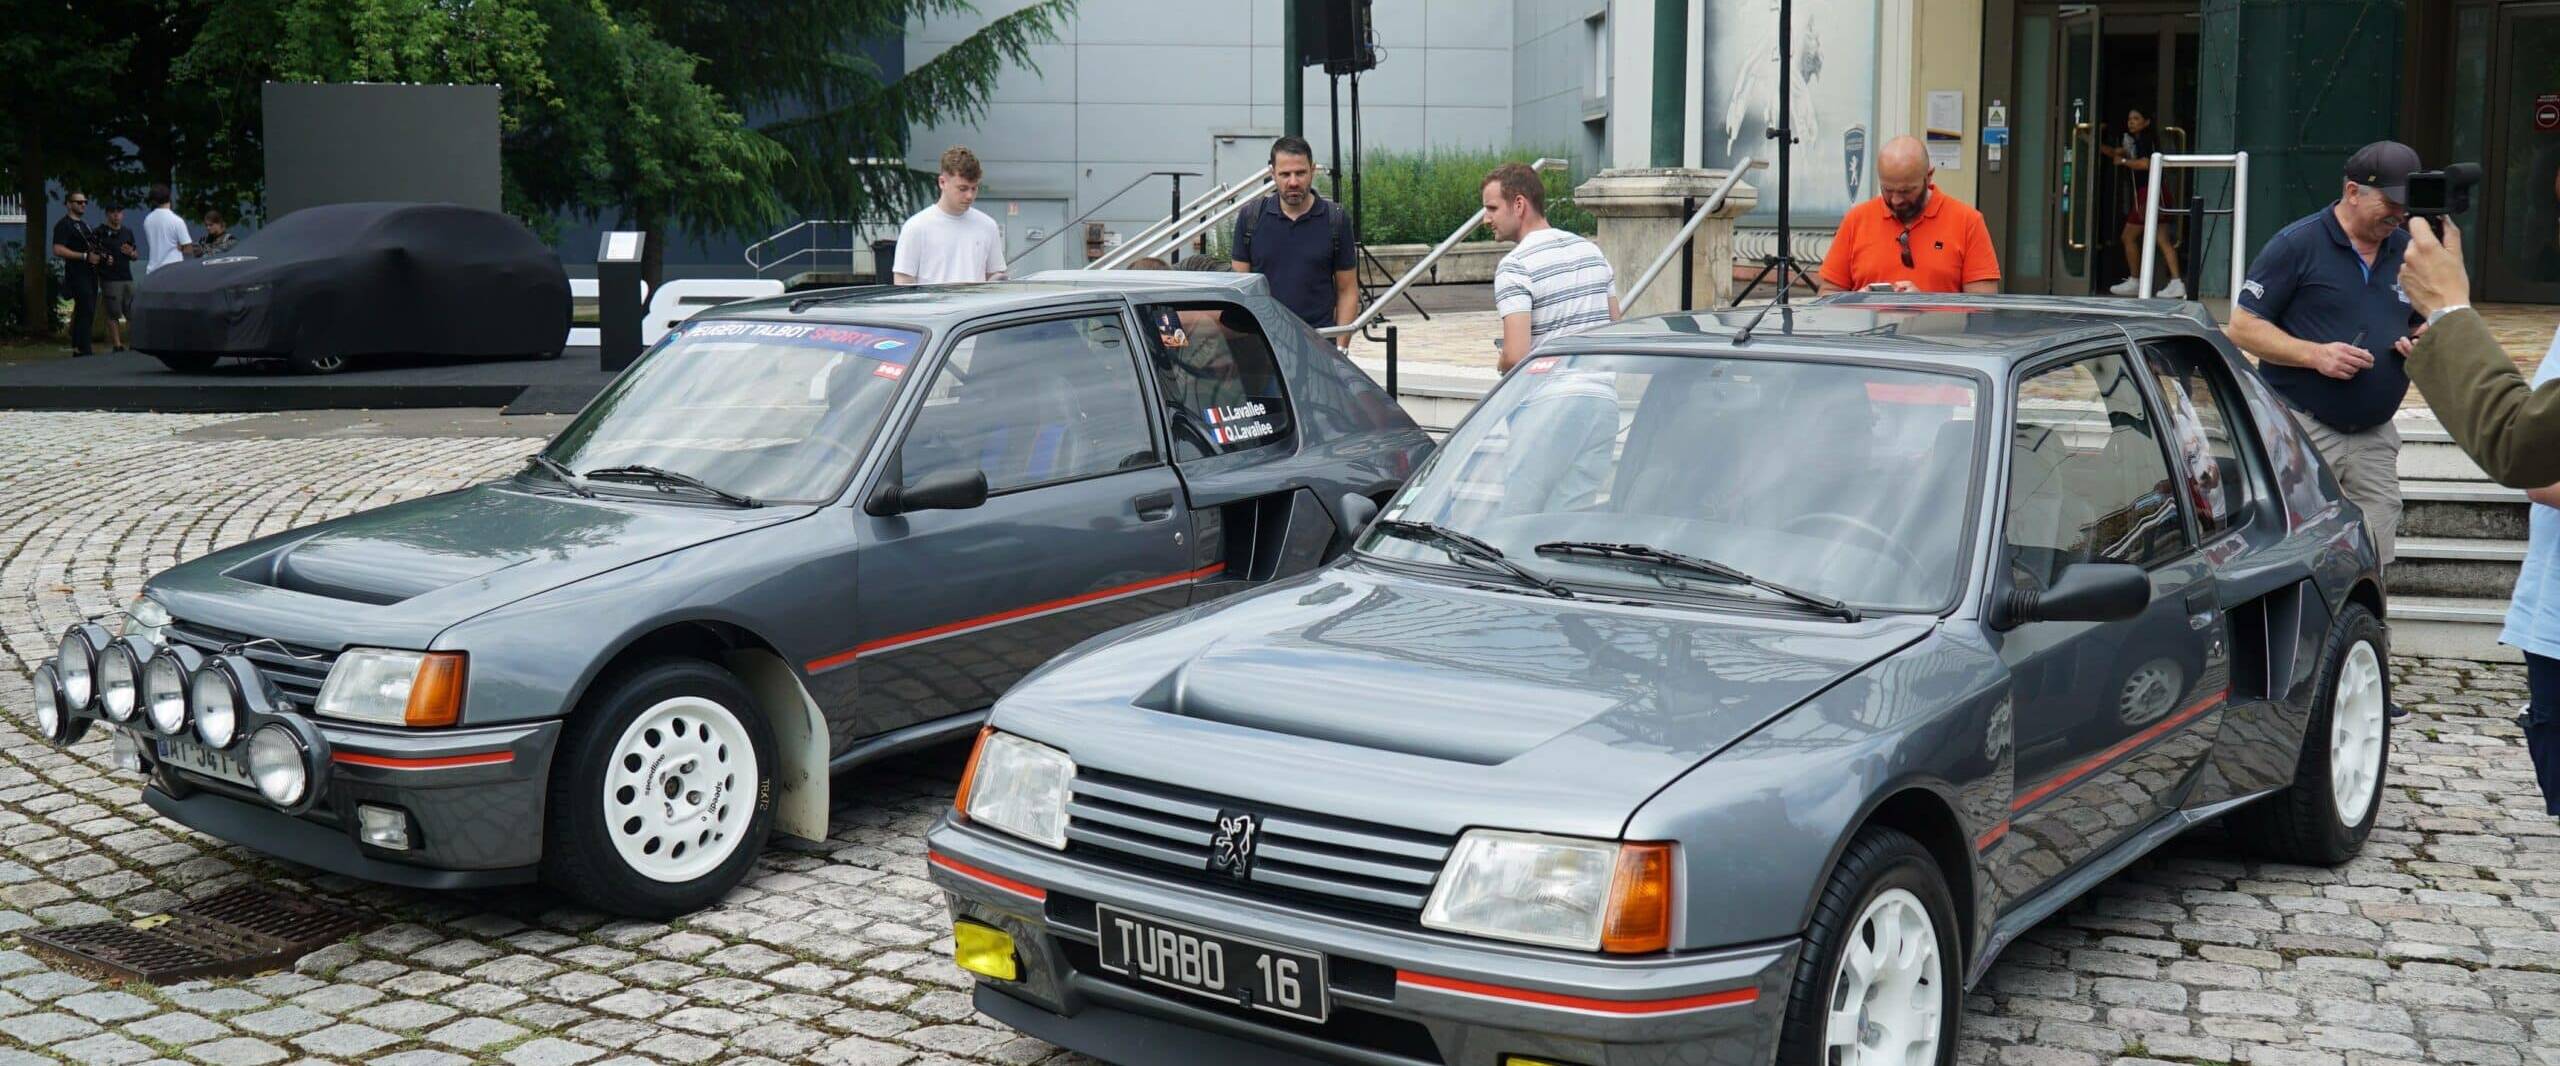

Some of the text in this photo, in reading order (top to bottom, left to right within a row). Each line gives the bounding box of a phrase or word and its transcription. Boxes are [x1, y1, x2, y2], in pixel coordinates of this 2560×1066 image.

[690, 324, 868, 345] PEUGEOT TALBOT SPORT
[1218, 401, 1266, 421] L.Lavallee
[1115, 918, 1302, 1009] TURBO 16
